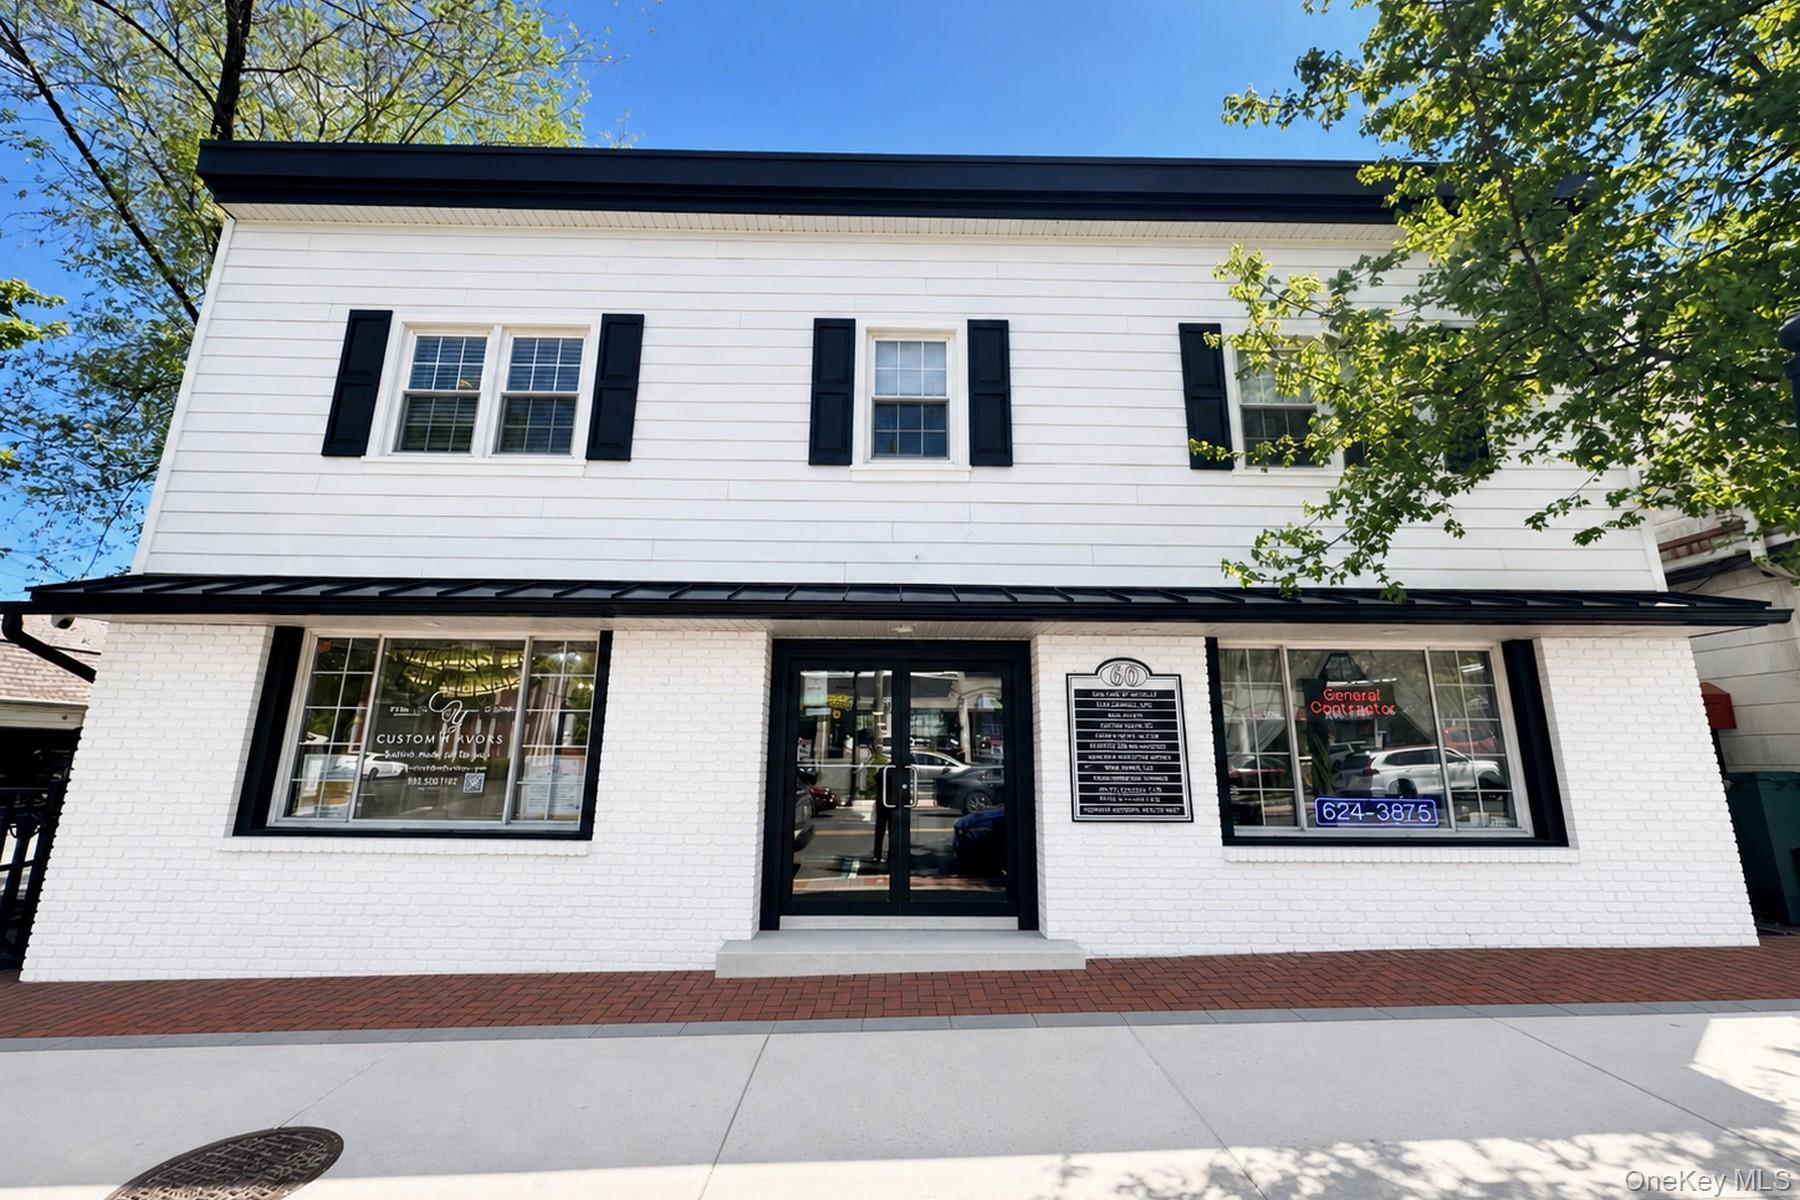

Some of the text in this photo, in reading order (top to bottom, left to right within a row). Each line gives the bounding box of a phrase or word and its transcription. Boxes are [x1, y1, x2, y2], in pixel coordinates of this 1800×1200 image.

[1110, 664, 1139, 687] 60
[1323, 688, 1380, 701] General
[1310, 701, 1396, 716] Contractor
[376, 734, 435, 745] CUSTOM
[1322, 802, 1431, 822] 624-3875
